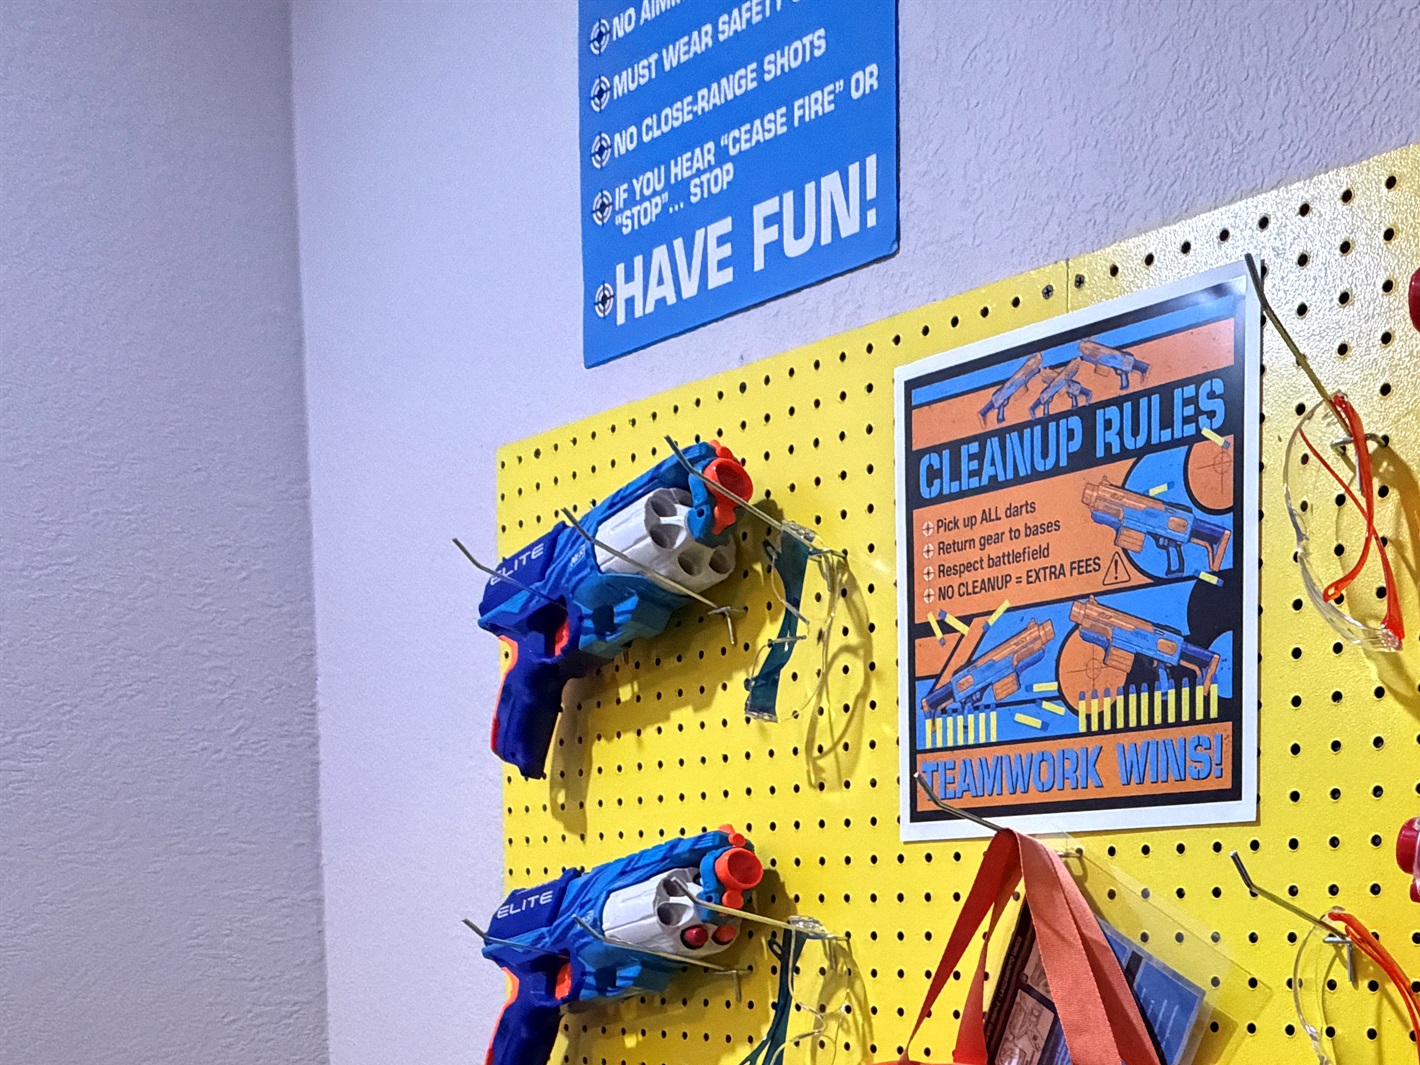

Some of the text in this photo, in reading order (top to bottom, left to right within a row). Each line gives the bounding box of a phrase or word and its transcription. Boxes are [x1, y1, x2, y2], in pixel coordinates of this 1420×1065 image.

[612, 7, 636, 41] NO
[613, 53, 658, 100] MUST
[662, 23, 713, 73] WEAR
[613, 28, 826, 158] NO CLOSE-RANGE SHOTS
[615, 63, 879, 211] IF YOU HEAR “CEASE FIRE” OR
[689, 162, 734, 203] STOP
[615, 153, 878, 326] HAVE FUN!
[919, 378, 1226, 499] CLEANUP RULES
[936, 499, 1037, 535] Pick up ALL darts
[938, 519, 1061, 557] Return gear to bases
[489, 543, 544, 586] ELITE
[938, 543, 1050, 580] Respect battlefield
[938, 556, 1101, 602] NO CLEANUP = EXTRA FEES
[920, 732, 1224, 801] TEAMWORK WINS!
[496, 890, 553, 919] ELITE
